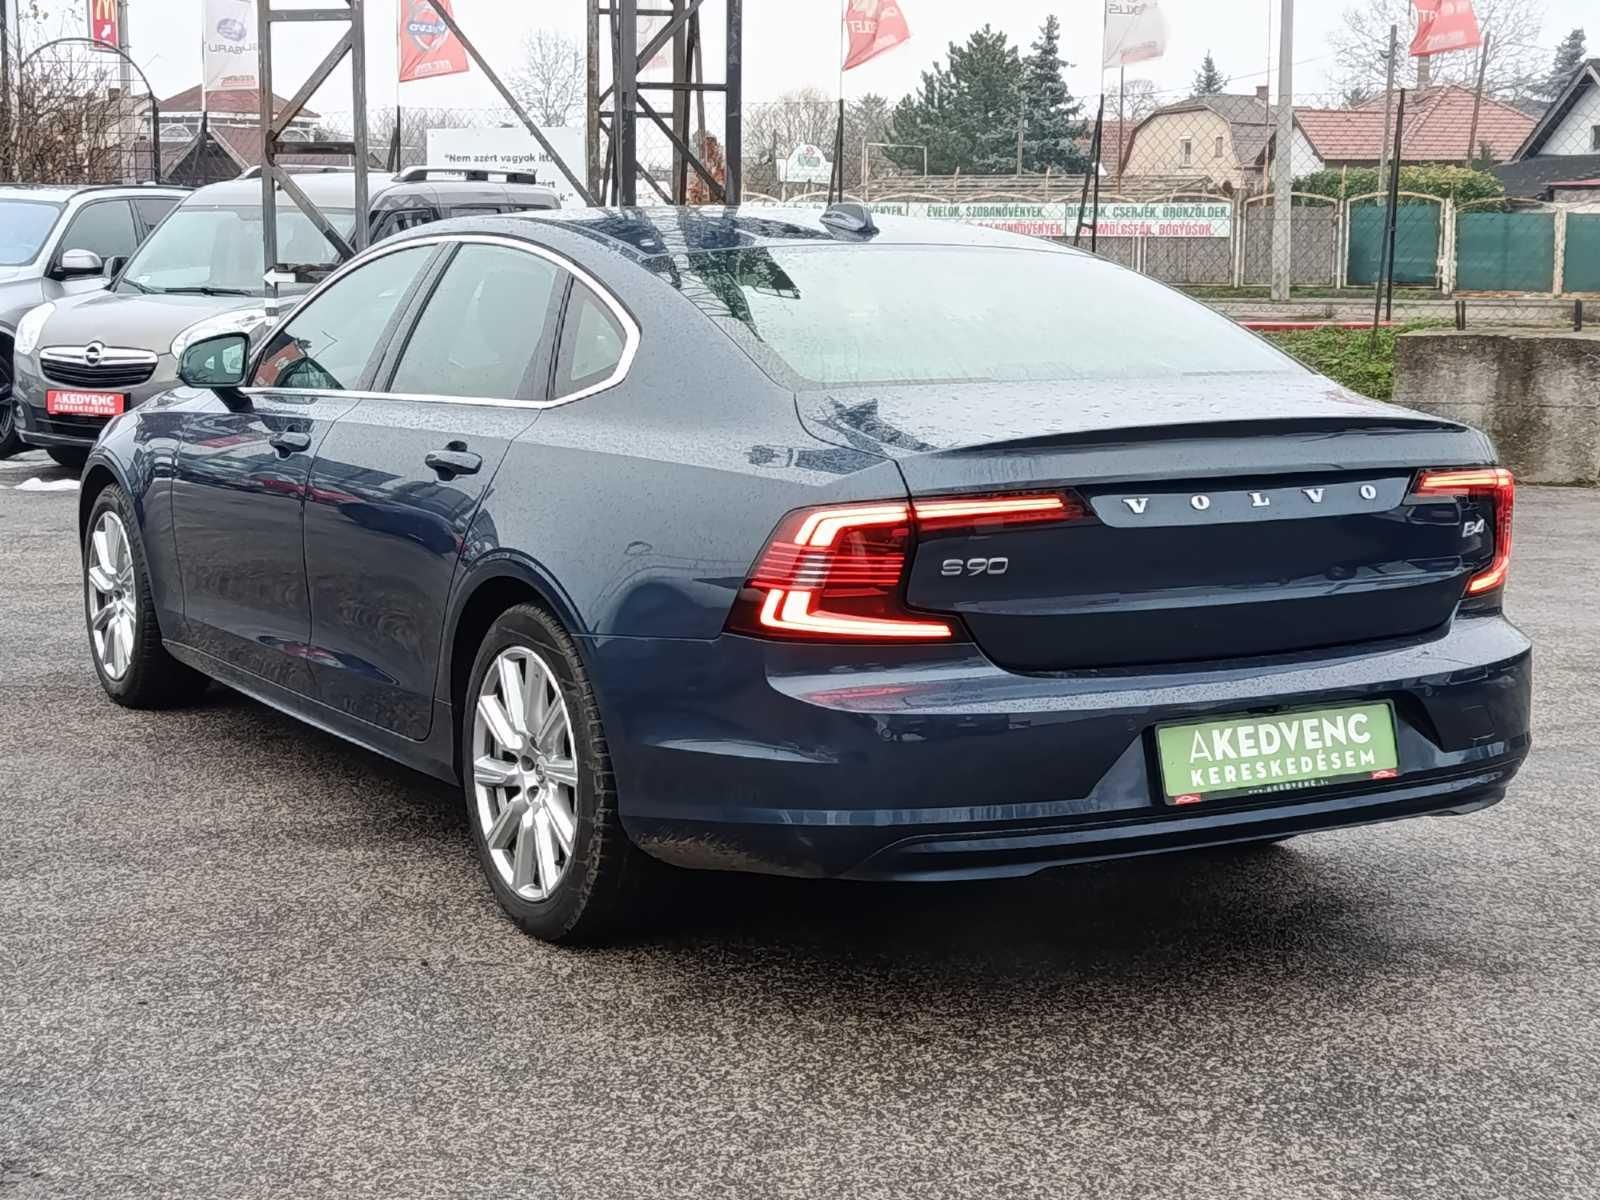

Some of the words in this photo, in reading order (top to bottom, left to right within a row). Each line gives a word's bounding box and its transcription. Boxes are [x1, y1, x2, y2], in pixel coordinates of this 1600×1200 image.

[474, 154, 498, 163] azért
[501, 153, 535, 164] vagyok
[54, 391, 115, 407] AKEDVENC
[1122, 484, 1377, 515] VOLVO
[1462, 519, 1484, 537] B4
[941, 557, 1008, 576] S90
[1189, 713, 1372, 763] AKEDVENC
[1191, 749, 1376, 787] KERESKEDÉSEM
